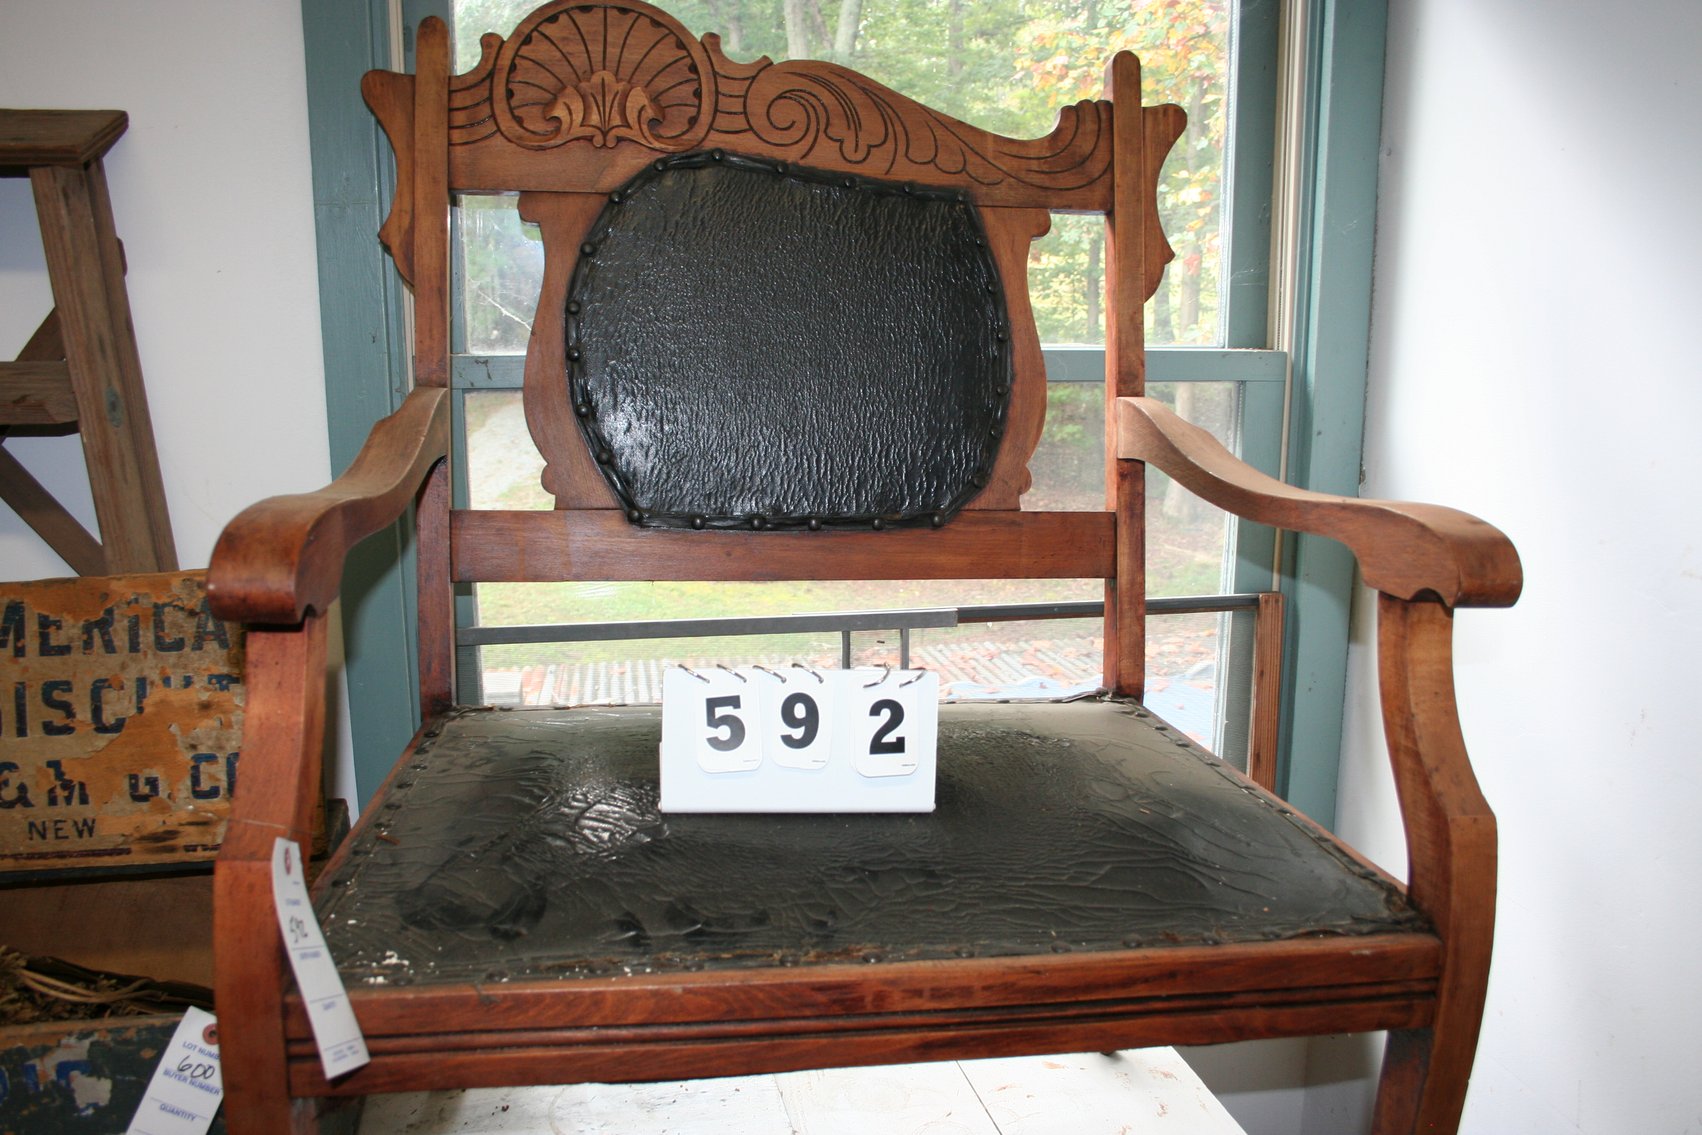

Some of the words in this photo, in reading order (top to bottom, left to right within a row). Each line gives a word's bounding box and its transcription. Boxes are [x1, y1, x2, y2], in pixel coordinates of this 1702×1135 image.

[705, 692, 905, 755] 592
[28, 818, 96, 841] NEW
[182, 1041, 198, 1051] LOT
[198, 1047, 220, 1061] NUMB
[177, 1055, 215, 1080] 600
[163, 1067, 189, 1083] BUYER
[188, 1079, 221, 1096] NUMBER
[159, 1103, 197, 1121] QUANTITY
